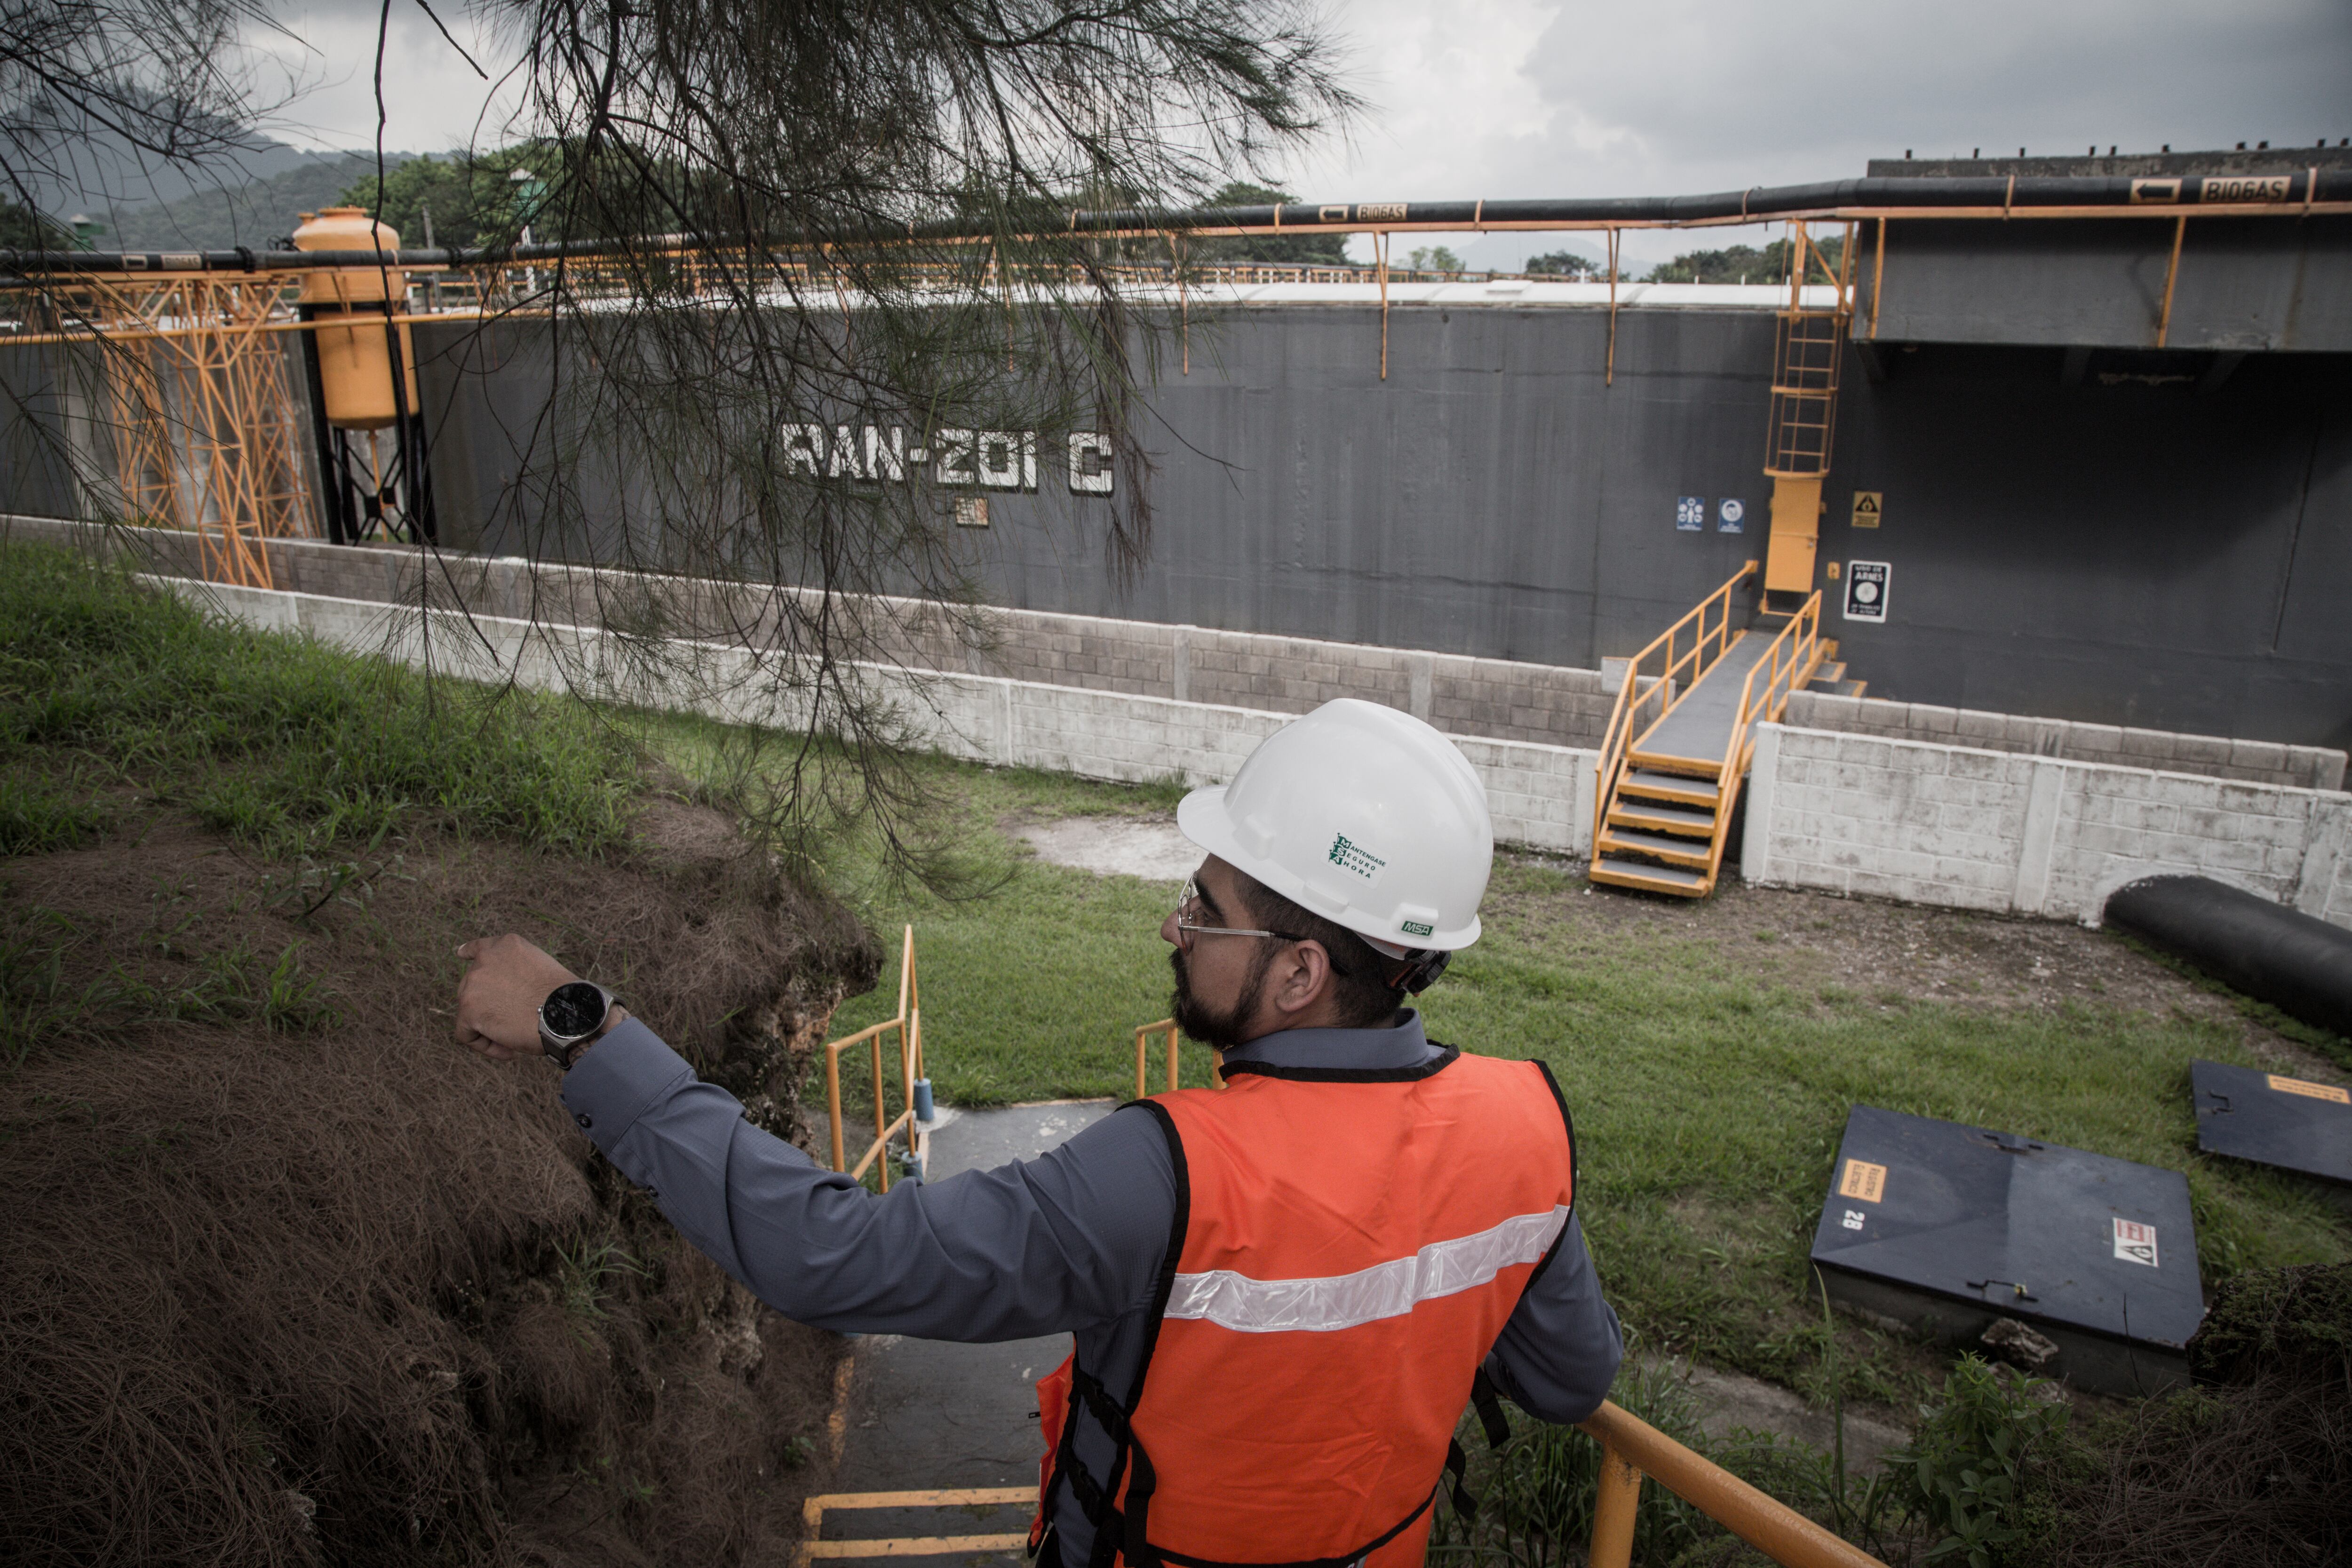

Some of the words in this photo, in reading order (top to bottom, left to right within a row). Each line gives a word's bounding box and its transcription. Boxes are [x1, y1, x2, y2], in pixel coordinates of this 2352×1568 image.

[2207, 180, 2283, 200] BIOGAS
[1361, 206, 1403, 220] BIOGAS
[1069, 432, 1112, 492] C
[1855, 571, 1883, 582] ARNES
[1337, 847, 1375, 871] SEGURO
[1341, 838, 1386, 867] MANTENGASE
[1332, 856, 1371, 879] AHORA
[1404, 922, 1430, 935] MSA
[1843, 1210, 1865, 1230] 28
